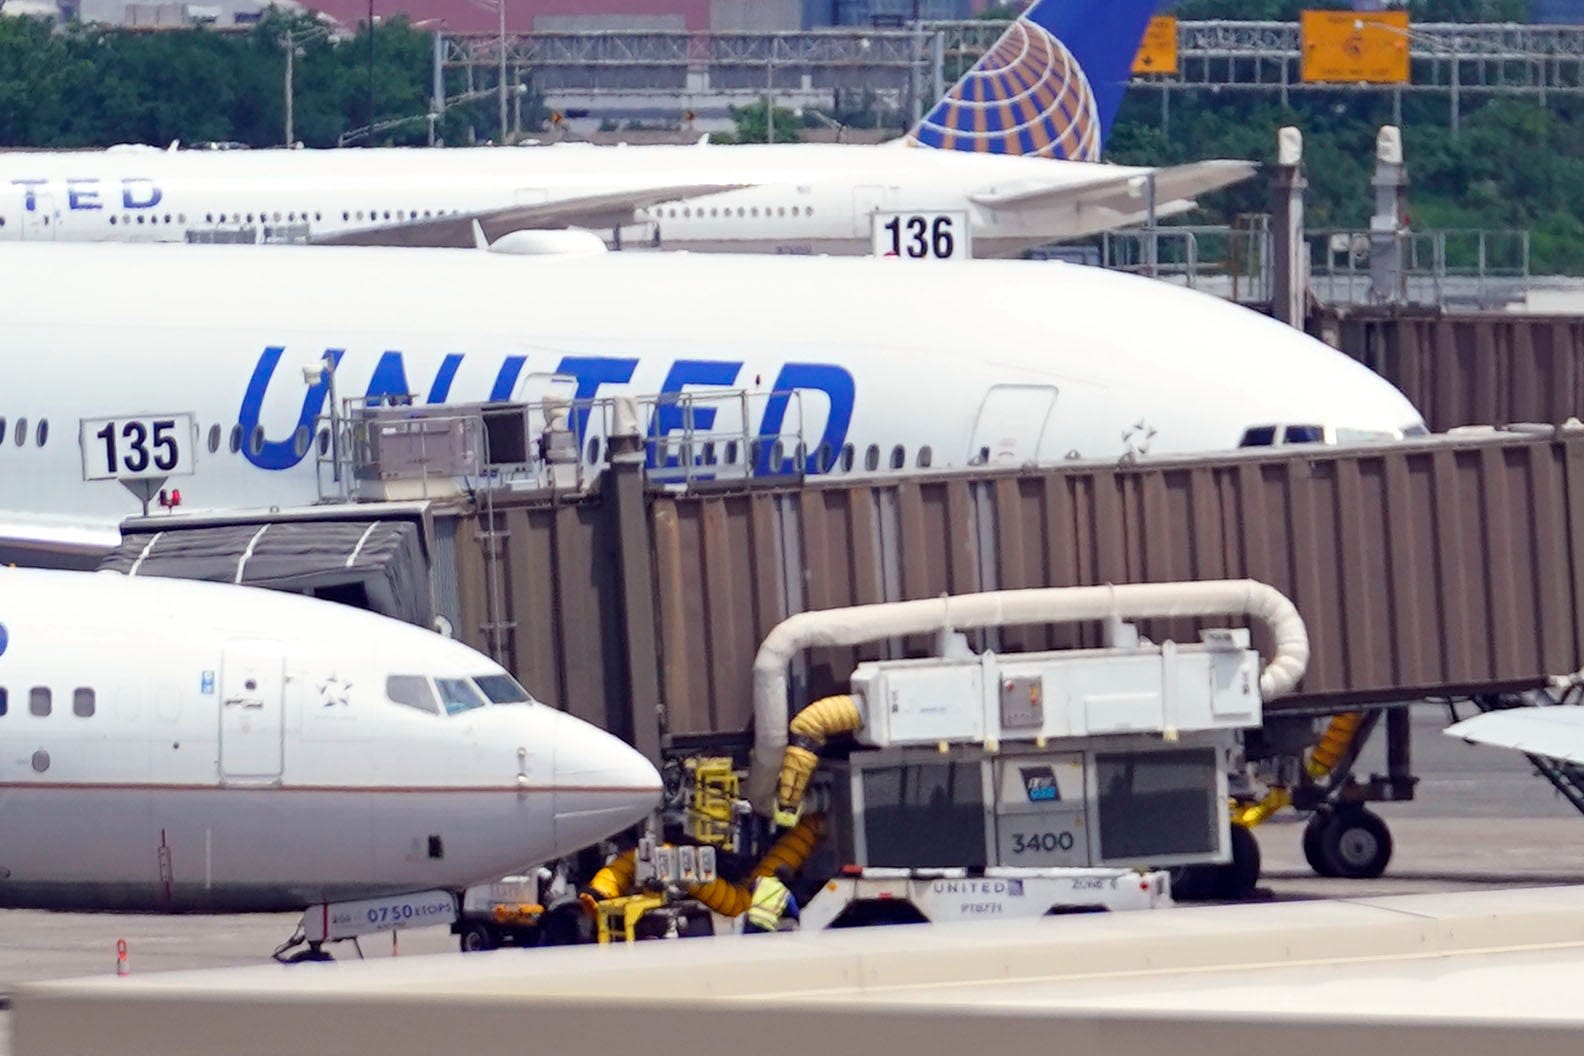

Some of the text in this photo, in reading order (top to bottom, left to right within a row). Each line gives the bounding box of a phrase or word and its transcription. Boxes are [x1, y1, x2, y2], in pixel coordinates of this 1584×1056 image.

[885, 216, 953, 258] 136
[97, 420, 178, 473] 135
[1012, 831, 1074, 855] 3400
[933, 879, 1006, 894] UNITED
[367, 904, 413, 923] 0750
